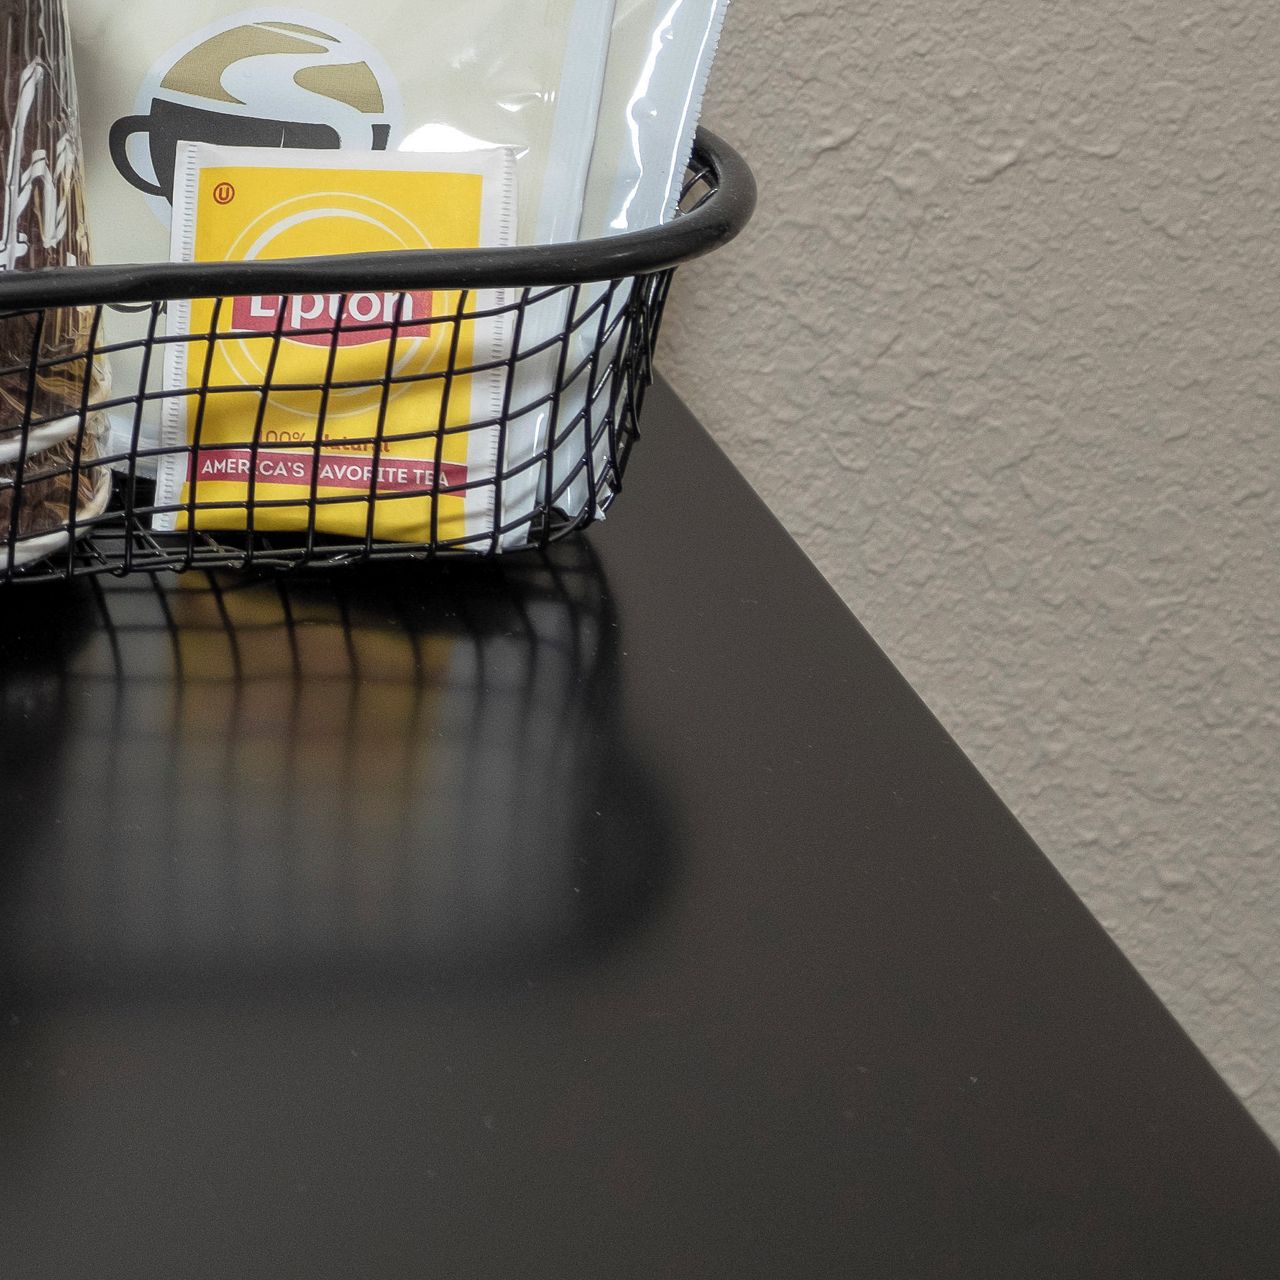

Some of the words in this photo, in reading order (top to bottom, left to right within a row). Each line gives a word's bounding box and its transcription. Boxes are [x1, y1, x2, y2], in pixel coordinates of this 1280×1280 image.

[250, 292, 413, 330] Lpton
[201, 458, 306, 478] AMERCA'S
[316, 463, 408, 485] AVORITE
[412, 468, 450, 487] TEA
